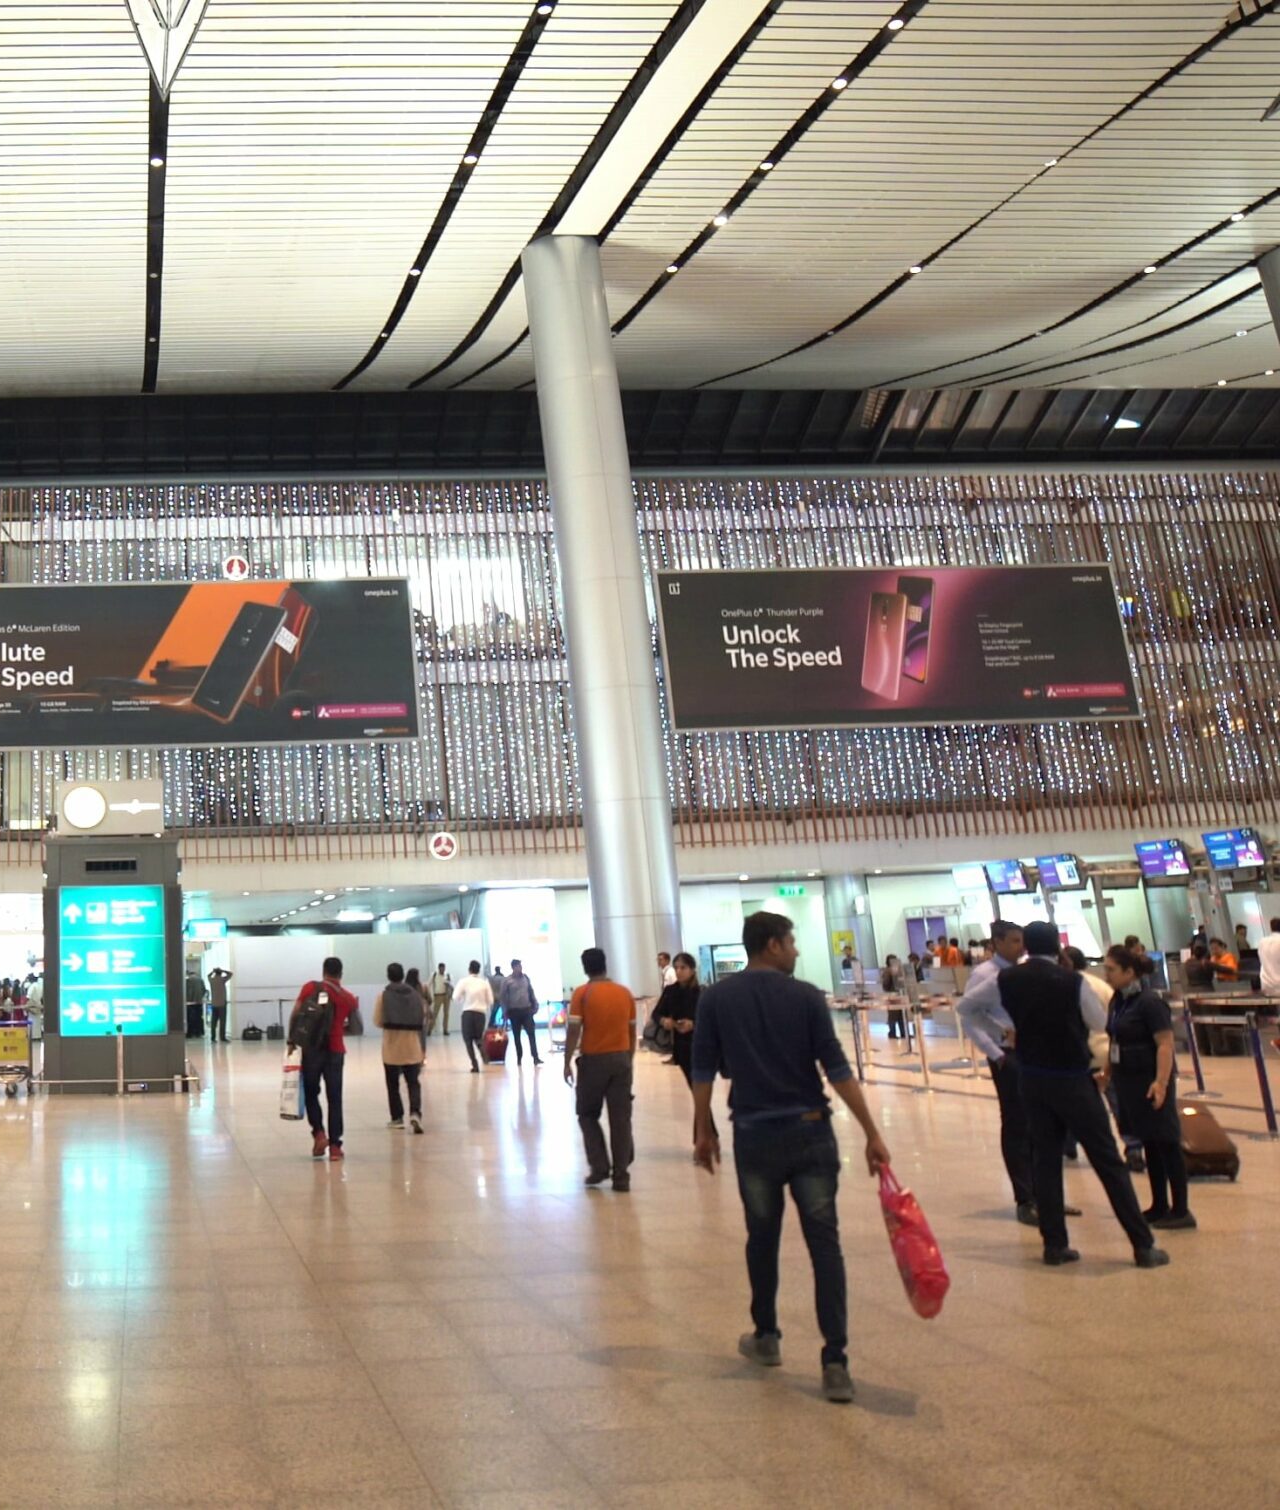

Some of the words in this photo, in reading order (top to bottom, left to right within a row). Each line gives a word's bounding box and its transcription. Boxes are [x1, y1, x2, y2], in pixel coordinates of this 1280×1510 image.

[364, 589, 399, 597] oneplus.in
[721, 609, 752, 617] OnePlus
[766, 608, 798, 617] Thunder
[799, 608, 824, 617] Purple
[18, 624, 51, 633] McLaren
[52, 624, 80, 632] Edition
[722, 624, 801, 645] Unlock
[725, 648, 769, 668] The
[773, 646, 842, 671] Speed
[1, 665, 74, 690] Speed
